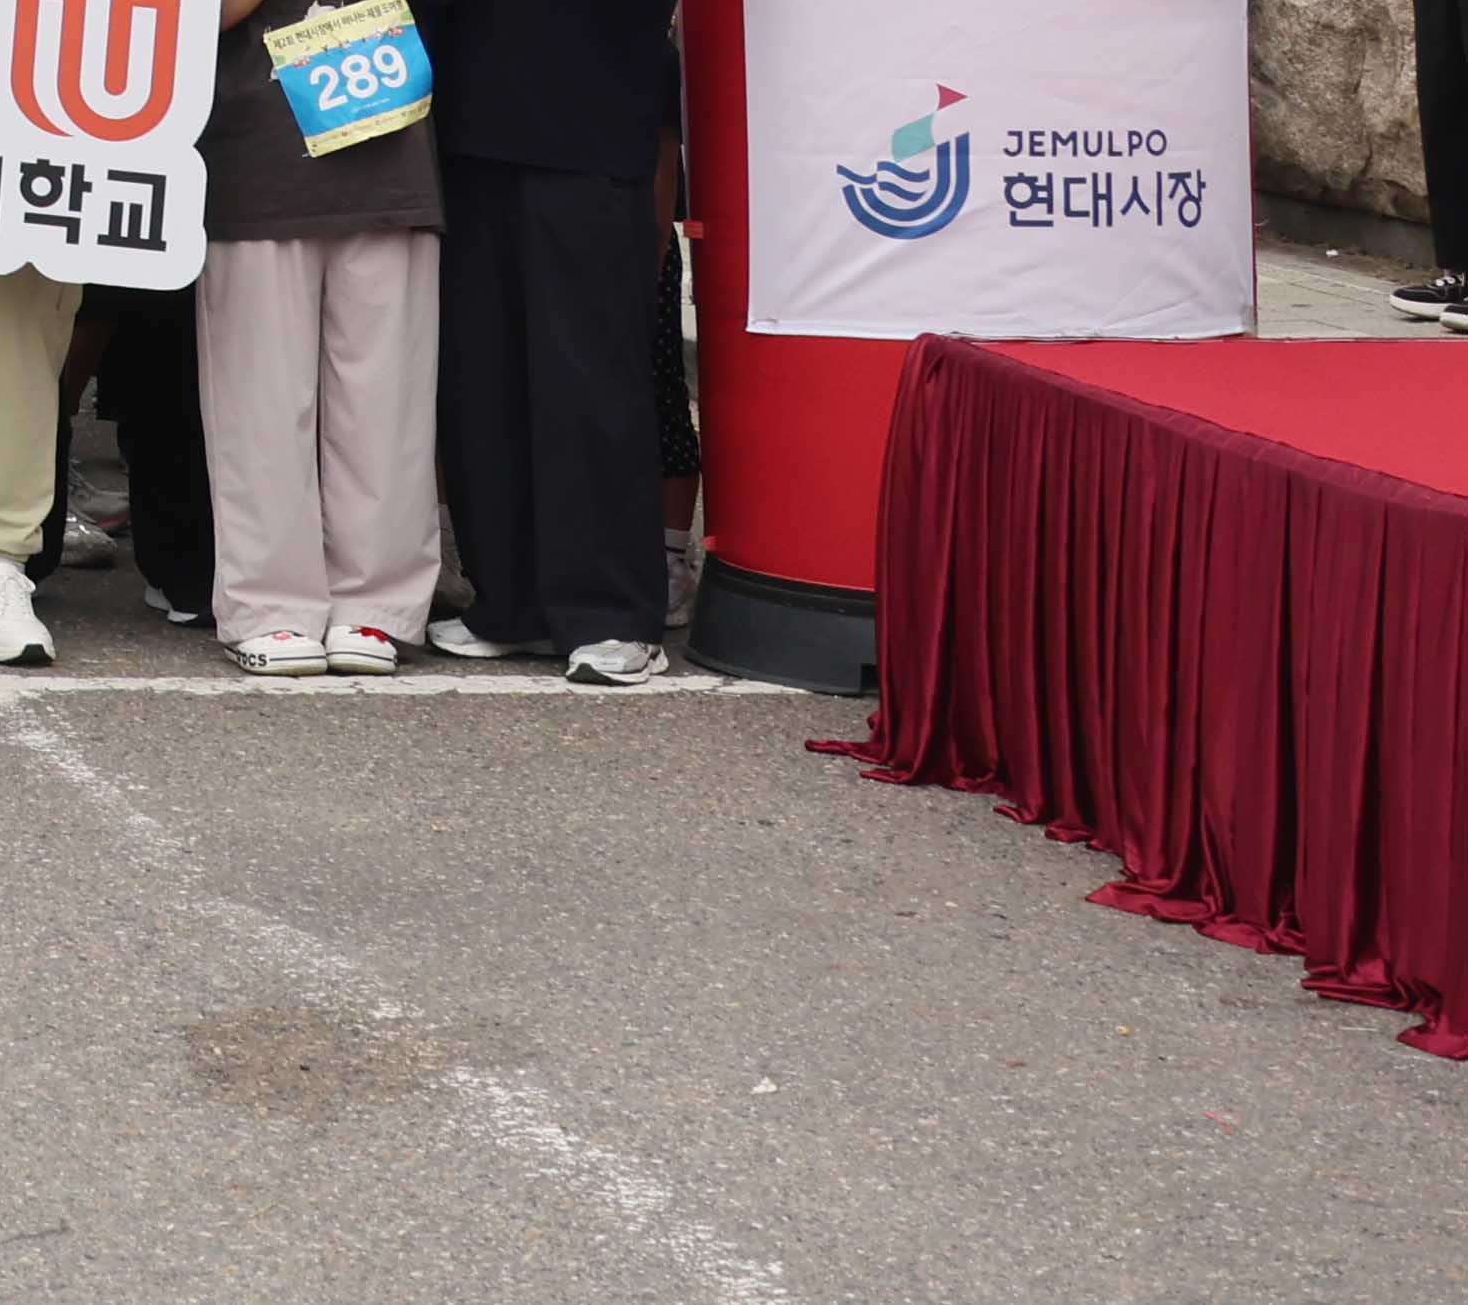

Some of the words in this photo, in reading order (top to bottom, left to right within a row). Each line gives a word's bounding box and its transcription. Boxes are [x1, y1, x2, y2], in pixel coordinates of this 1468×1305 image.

[310, 45, 408, 112] 289
[1004, 130, 1166, 156] JEMULPO
[1004, 170, 1206, 227] 현대시장
